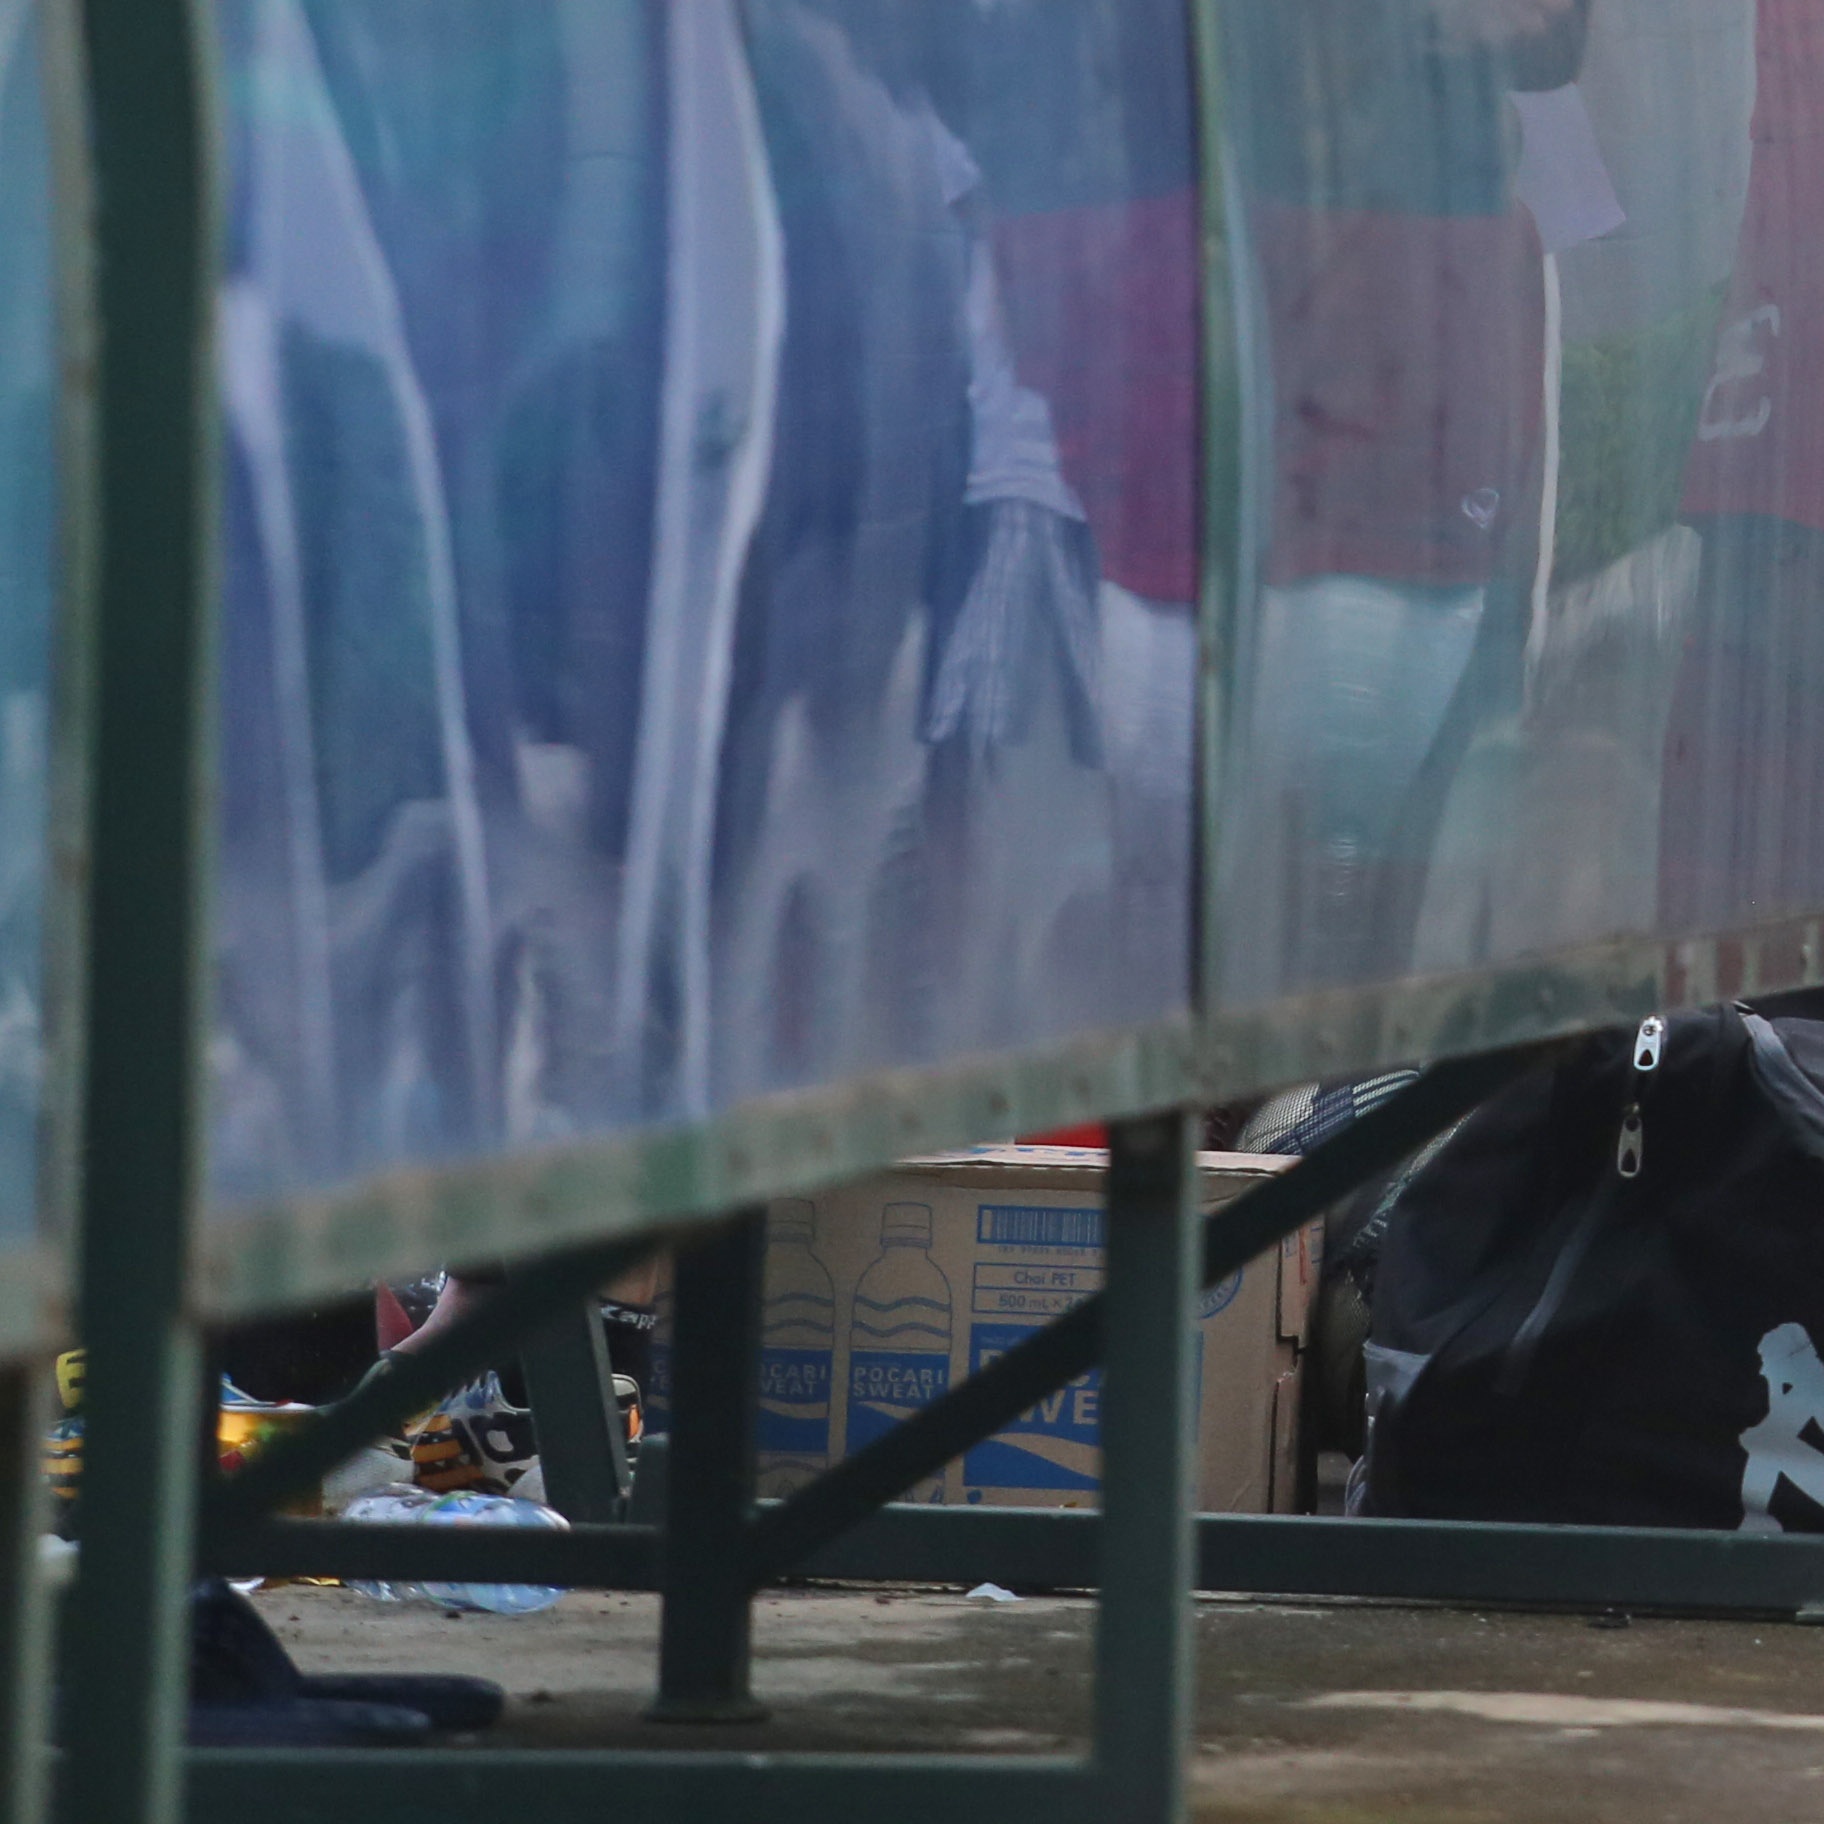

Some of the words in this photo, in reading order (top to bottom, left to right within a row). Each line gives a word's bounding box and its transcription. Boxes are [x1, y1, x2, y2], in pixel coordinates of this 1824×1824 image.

[1051, 1271, 1077, 1287] PET
[997, 1292, 1026, 1308] 500
[759, 1362, 828, 1381] CARI
[853, 1365, 945, 1385] POCARI
[852, 1381, 936, 1400] SWEAT
